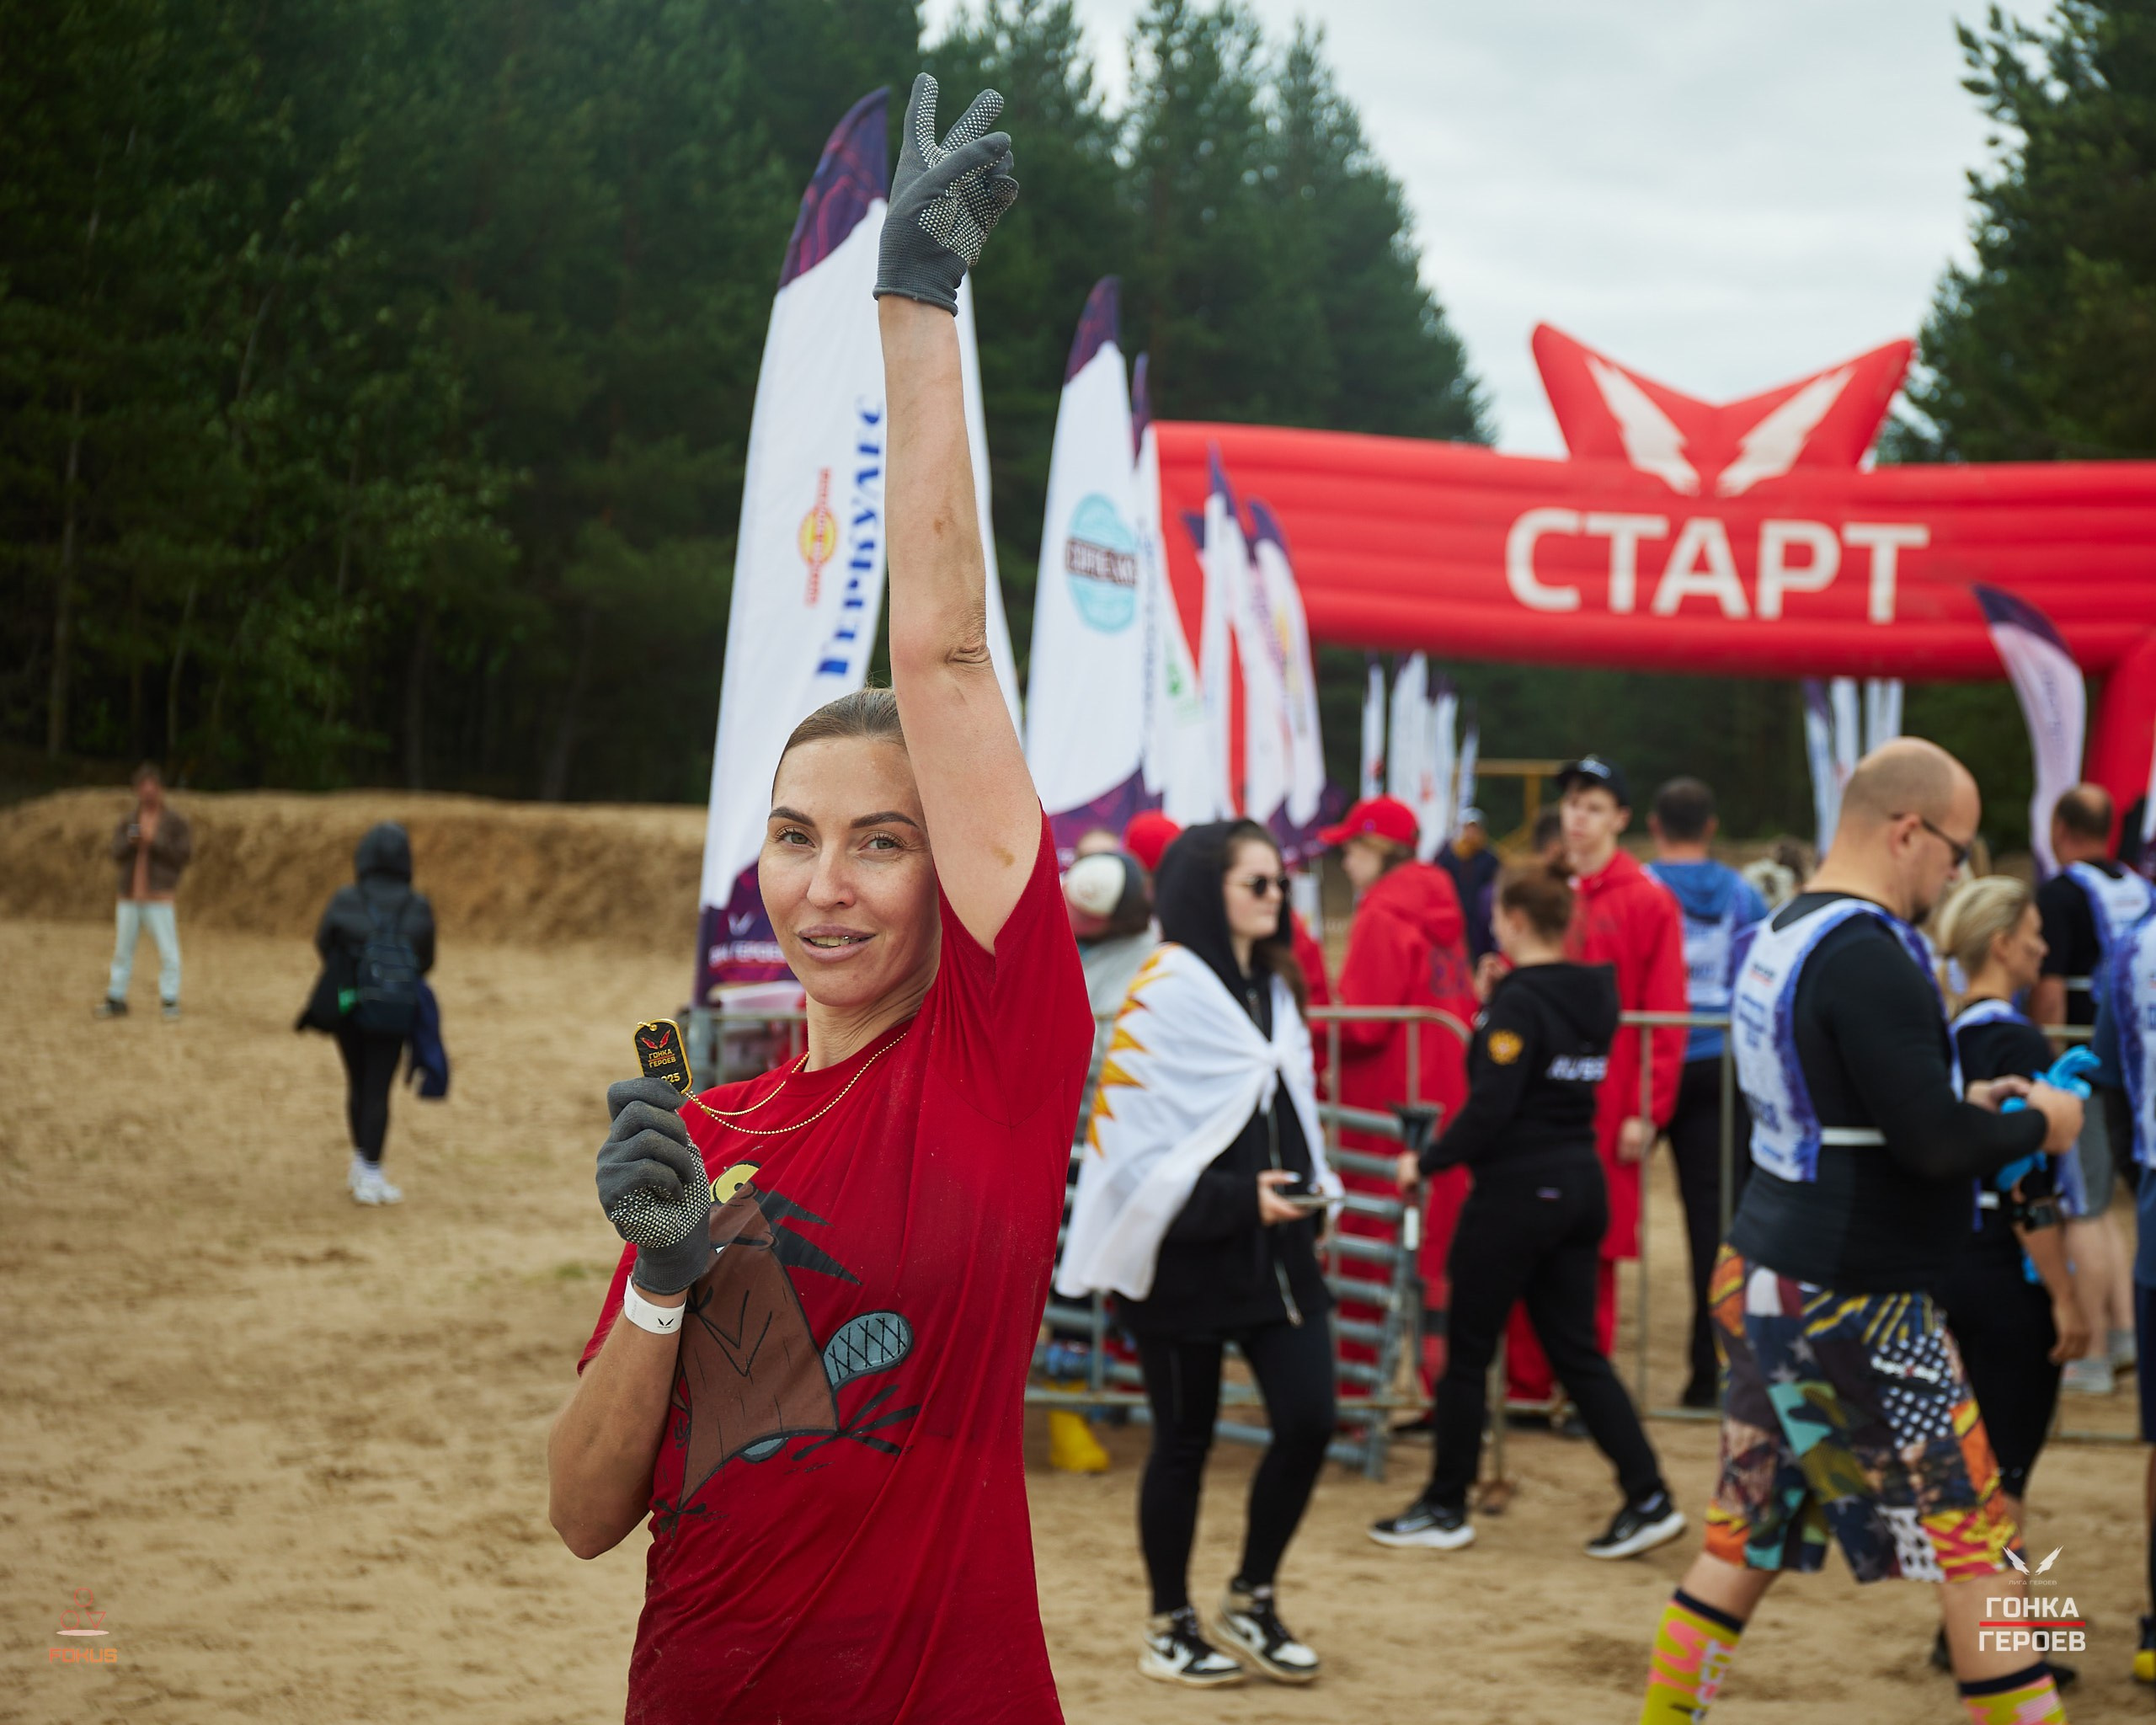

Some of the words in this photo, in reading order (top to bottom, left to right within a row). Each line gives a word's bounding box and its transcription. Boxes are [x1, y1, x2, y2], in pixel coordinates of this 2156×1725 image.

[1504, 507, 1931, 626] СТАРТ
[648, 1048, 673, 1060] ГОНКА
[648, 1056, 676, 1068] ГЕРОЕВ
